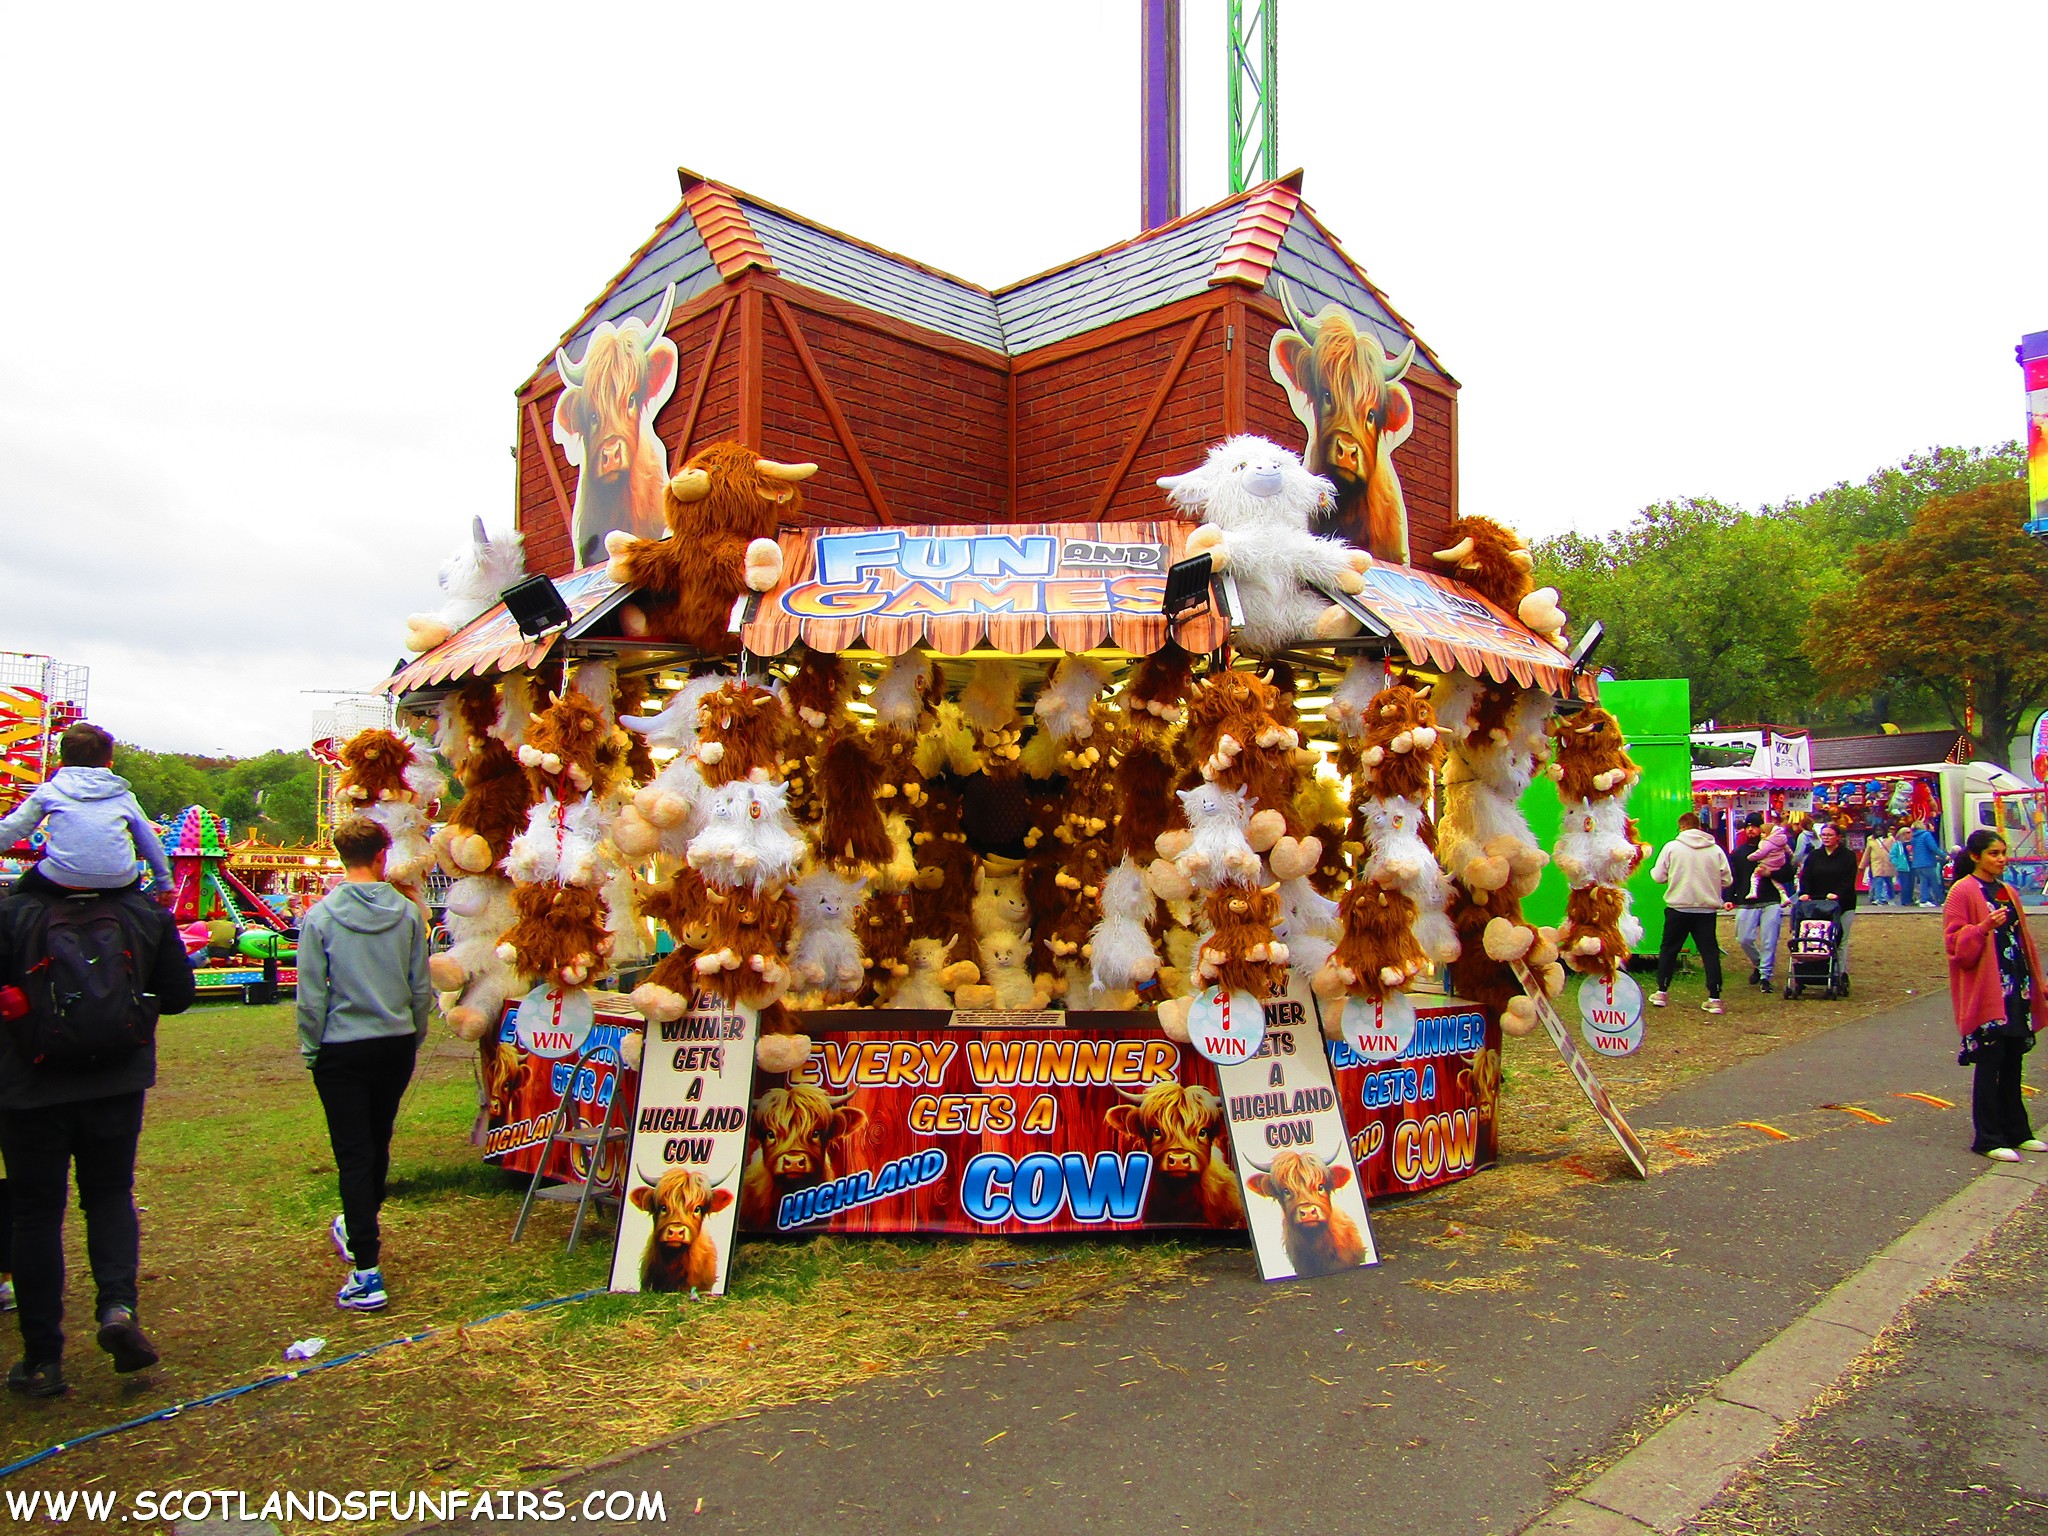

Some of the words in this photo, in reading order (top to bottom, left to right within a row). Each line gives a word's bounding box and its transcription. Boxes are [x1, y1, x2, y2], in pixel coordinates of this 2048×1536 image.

[815, 531, 1058, 586] FUN
[1061, 540, 1166, 569] AND
[780, 574, 1167, 619] GAMES
[250, 855, 274, 863] FOR
[661, 1015, 746, 1041] WINNER
[1592, 1009, 1627, 1026] WIN
[533, 1031, 575, 1050] WIN
[1205, 1037, 1247, 1056] WIN
[1254, 1031, 1296, 1059] ETS
[1358, 1035, 1399, 1052] WIN
[1395, 1012, 1486, 1063] INNER
[1595, 1035, 1630, 1051] WIN
[672, 1046, 726, 1071] GETS
[788, 1040, 957, 1087] EVERY
[967, 1040, 1180, 1086] WINNER
[685, 1076, 704, 1102] A
[1269, 1063, 1286, 1088] A
[1362, 1067, 1418, 1110] GETS
[1420, 1064, 1436, 1101] A
[596, 1072, 615, 1108] A
[908, 1094, 1016, 1135] GETS
[1024, 1093, 1057, 1134] A
[1230, 1086, 1336, 1122] HIGHLAND
[638, 1106, 746, 1133] HIGHLAND
[1264, 1119, 1315, 1148] COW
[1392, 1106, 1479, 1184] COW
[663, 1137, 714, 1164] COW
[777, 1148, 948, 1230] HIGHLAND
[961, 1151, 1153, 1224] COW
